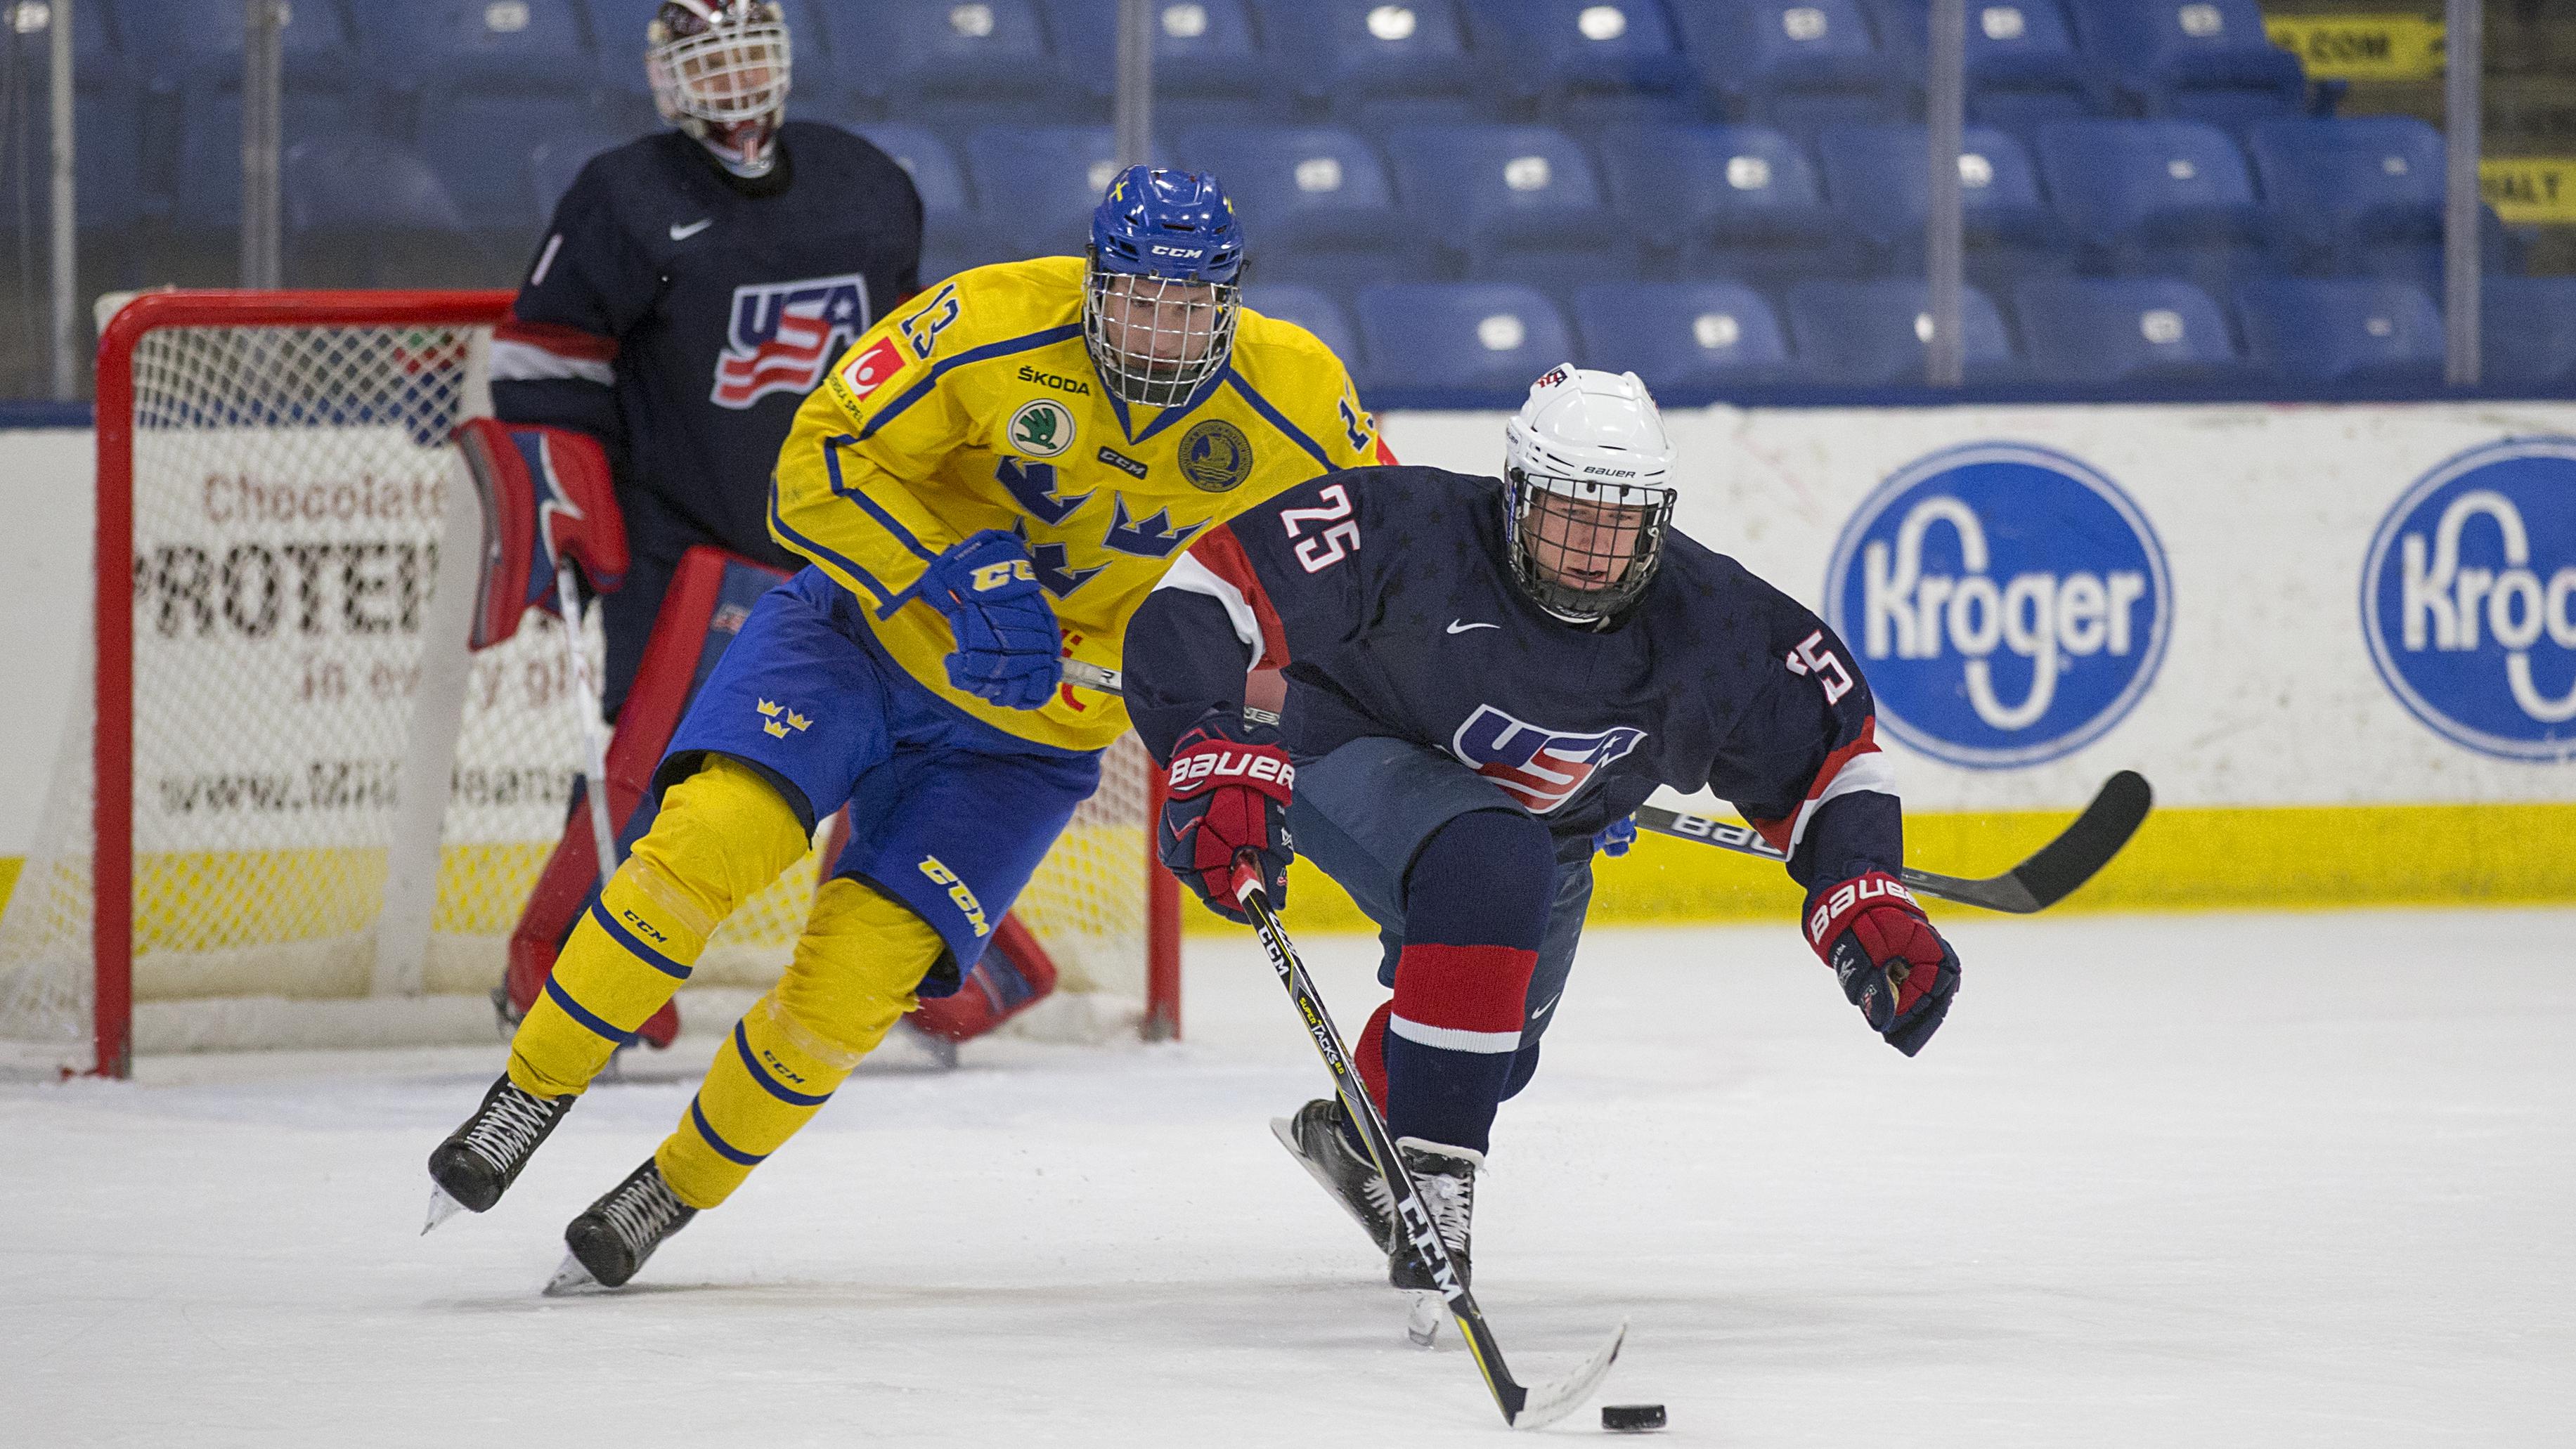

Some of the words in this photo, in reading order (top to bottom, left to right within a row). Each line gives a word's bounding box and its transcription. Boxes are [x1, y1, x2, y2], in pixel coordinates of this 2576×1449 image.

[1151, 245, 1203, 259] CCM
[709, 273, 873, 410] USA
[899, 282, 961, 361] 13
[1018, 365, 1090, 396] ŠKODA
[1099, 450, 1148, 476] CCM
[1584, 466, 1636, 479] BAUER
[1279, 483, 1361, 573] 25
[1862, 495, 2147, 731] Kroger
[1169, 751, 1295, 791] BAUER
[918, 855, 990, 937] CCM
[623, 909, 668, 943] CCM
[1258, 925, 1289, 976] CCM
[1299, 997, 1316, 1025] SUPER
[1311, 1023, 1339, 1065] TACKS
[763, 1049, 805, 1084] CCM
[1397, 1191, 1464, 1304] CCM
